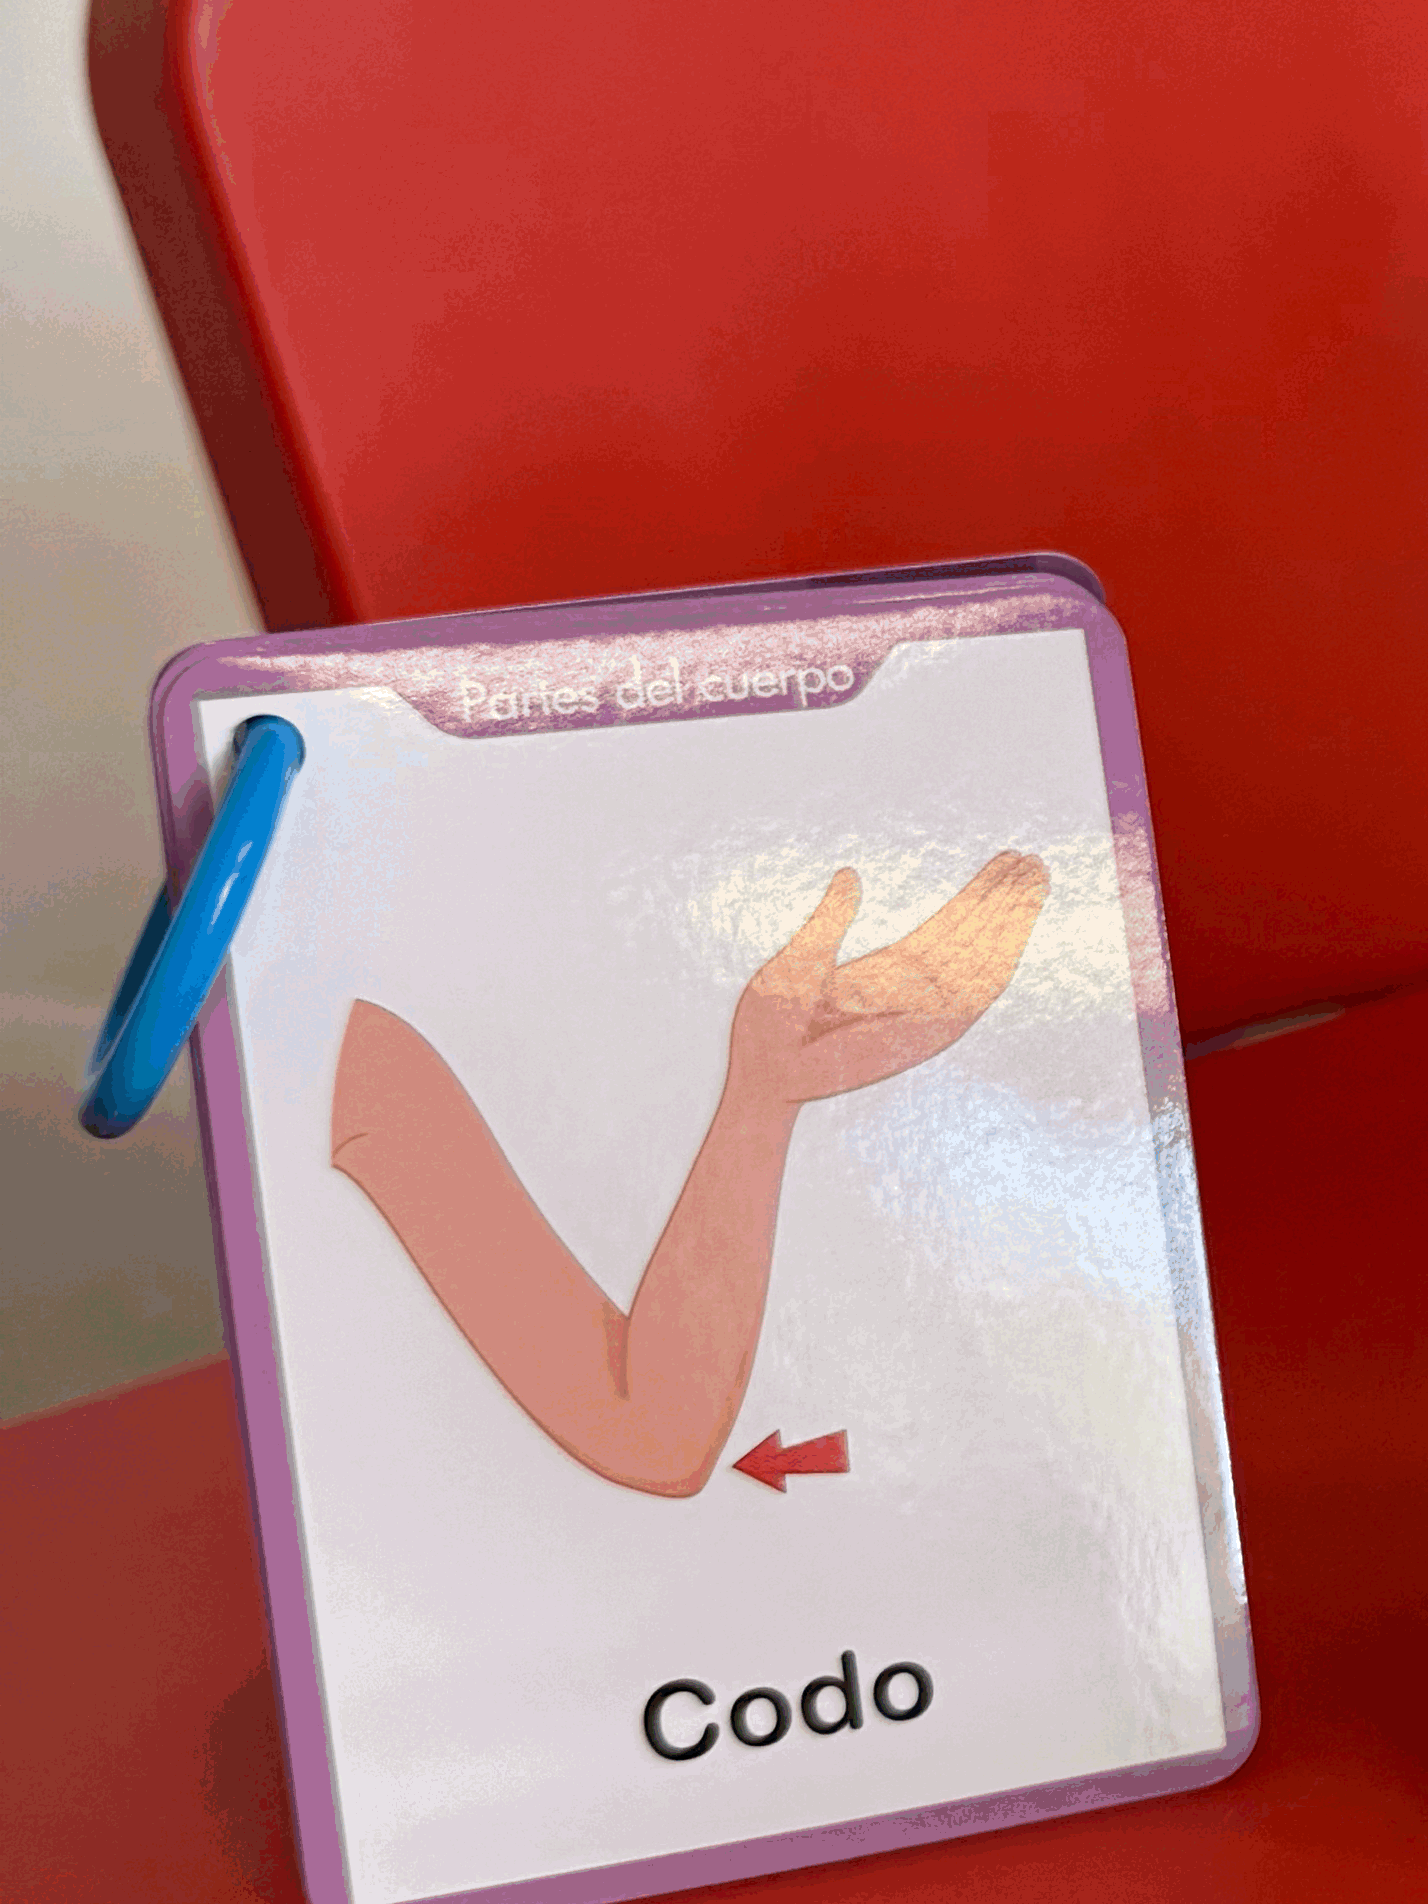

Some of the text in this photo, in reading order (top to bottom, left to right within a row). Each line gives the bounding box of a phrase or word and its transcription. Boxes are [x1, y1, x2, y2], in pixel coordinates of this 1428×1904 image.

[616, 654, 680, 710] del
[697, 662, 855, 709] cuerpo
[643, 1648, 934, 1762] Codo
